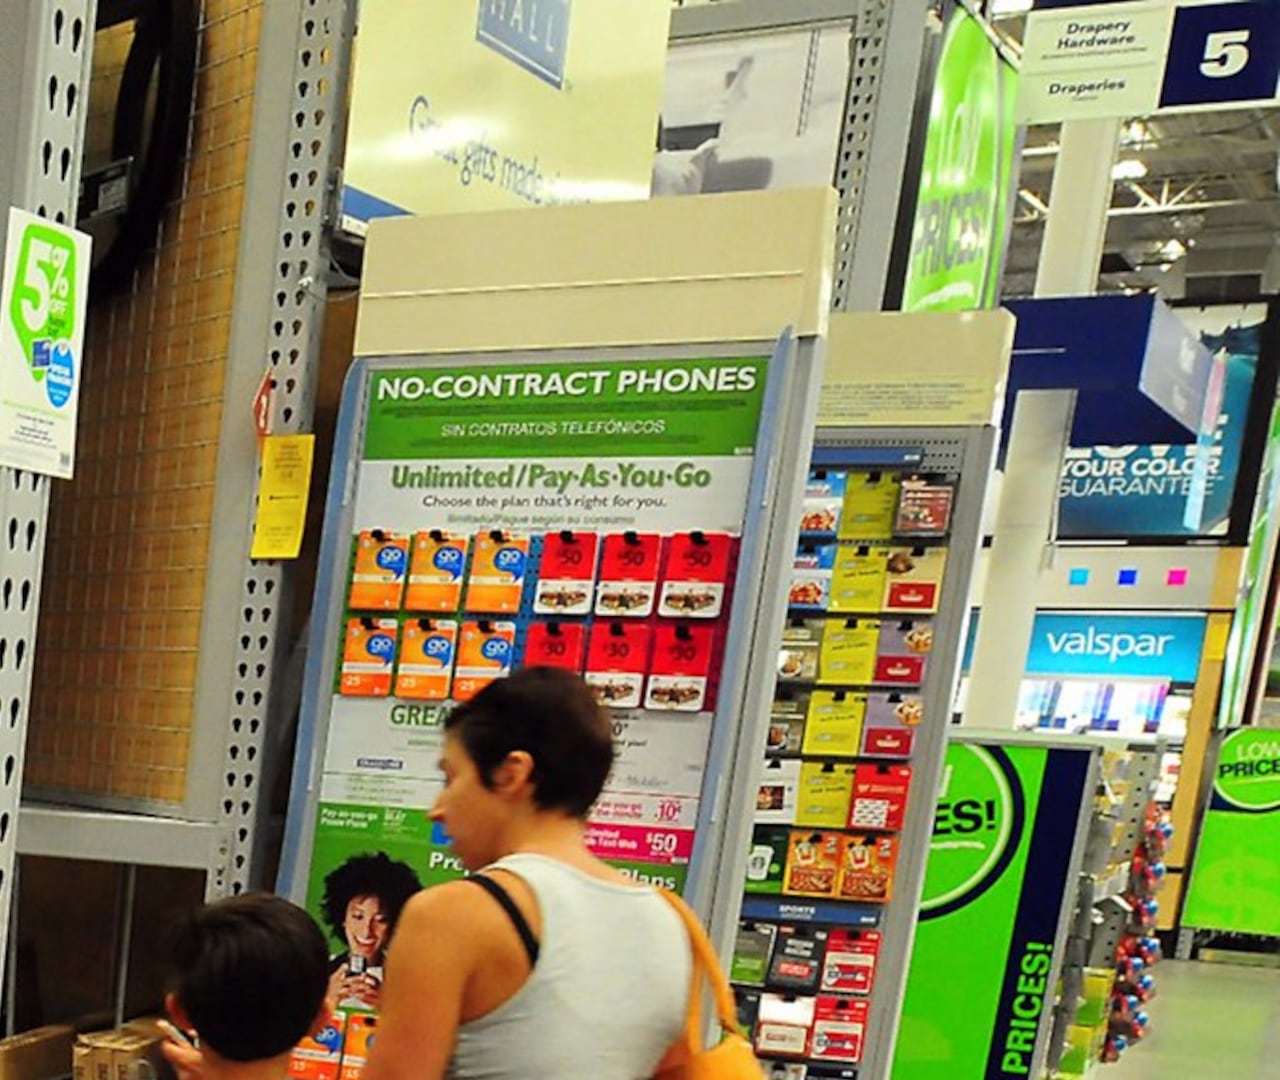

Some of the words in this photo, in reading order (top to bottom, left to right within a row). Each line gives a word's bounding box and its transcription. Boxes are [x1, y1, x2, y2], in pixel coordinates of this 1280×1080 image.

[1067, 22, 1130, 36] Drapery
[1057, 35, 1135, 50] Hardware
[1199, 30, 1251, 77] 5
[1049, 80, 1125, 96] Draperies
[379, 371, 610, 399] NO-CONTRACT
[617, 367, 755, 392] PHONES
[441, 424, 465, 436] SIN
[1061, 460, 1126, 476] YOUR
[1131, 459, 1220, 475] COLOR
[1058, 476, 1214, 497] GUARANTEE
[423, 495, 472, 507] Choose
[476, 495, 498, 507] the
[501, 495, 530, 509] plan
[534, 495, 571, 507] that's
[574, 495, 608, 510] right
[612, 495, 634, 507] for
[637, 498, 666, 510] you.
[1047, 627, 1173, 662] valspar
[1003, 941, 1054, 1073] PRICES!
